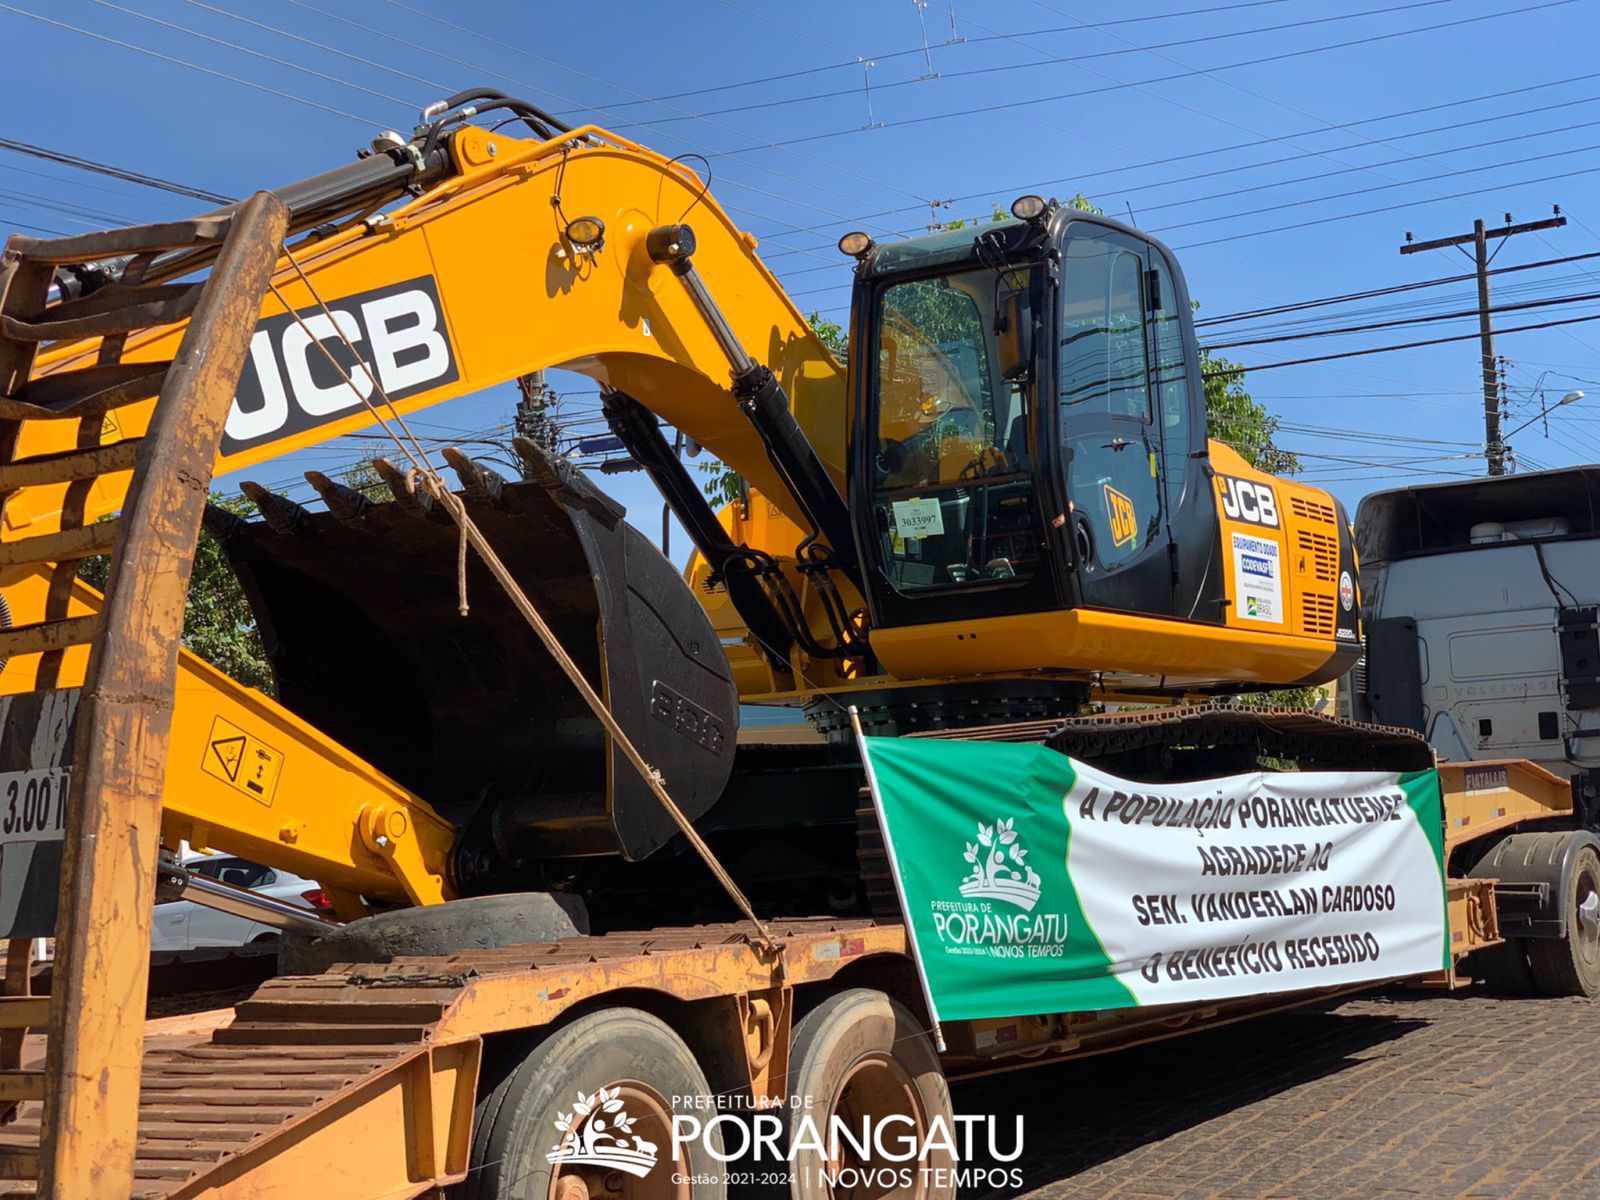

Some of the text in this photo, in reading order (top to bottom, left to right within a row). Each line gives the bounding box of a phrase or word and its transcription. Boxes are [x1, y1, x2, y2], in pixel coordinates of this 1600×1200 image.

[224, 289, 450, 440] JCB
[1109, 493, 1137, 540] JCB
[1222, 476, 1278, 526] JCB
[1465, 771, 1507, 790] FIATALLIS
[3, 776, 51, 834] 3.00
[1080, 787, 1403, 838] A POPULAÇÃO PORANGATUENSE
[1196, 842, 1333, 877] AGRADECE AO
[931, 900, 992, 913] PREFEITURA DE
[1131, 883, 1396, 927] SEN. VANDERLAN CARDOSO
[933, 913, 1068, 944] PORANGATU
[989, 945, 1064, 958] NOVOS TEMPOS
[1141, 931, 1381, 984] O BENEFÍCIO RECEBIDO
